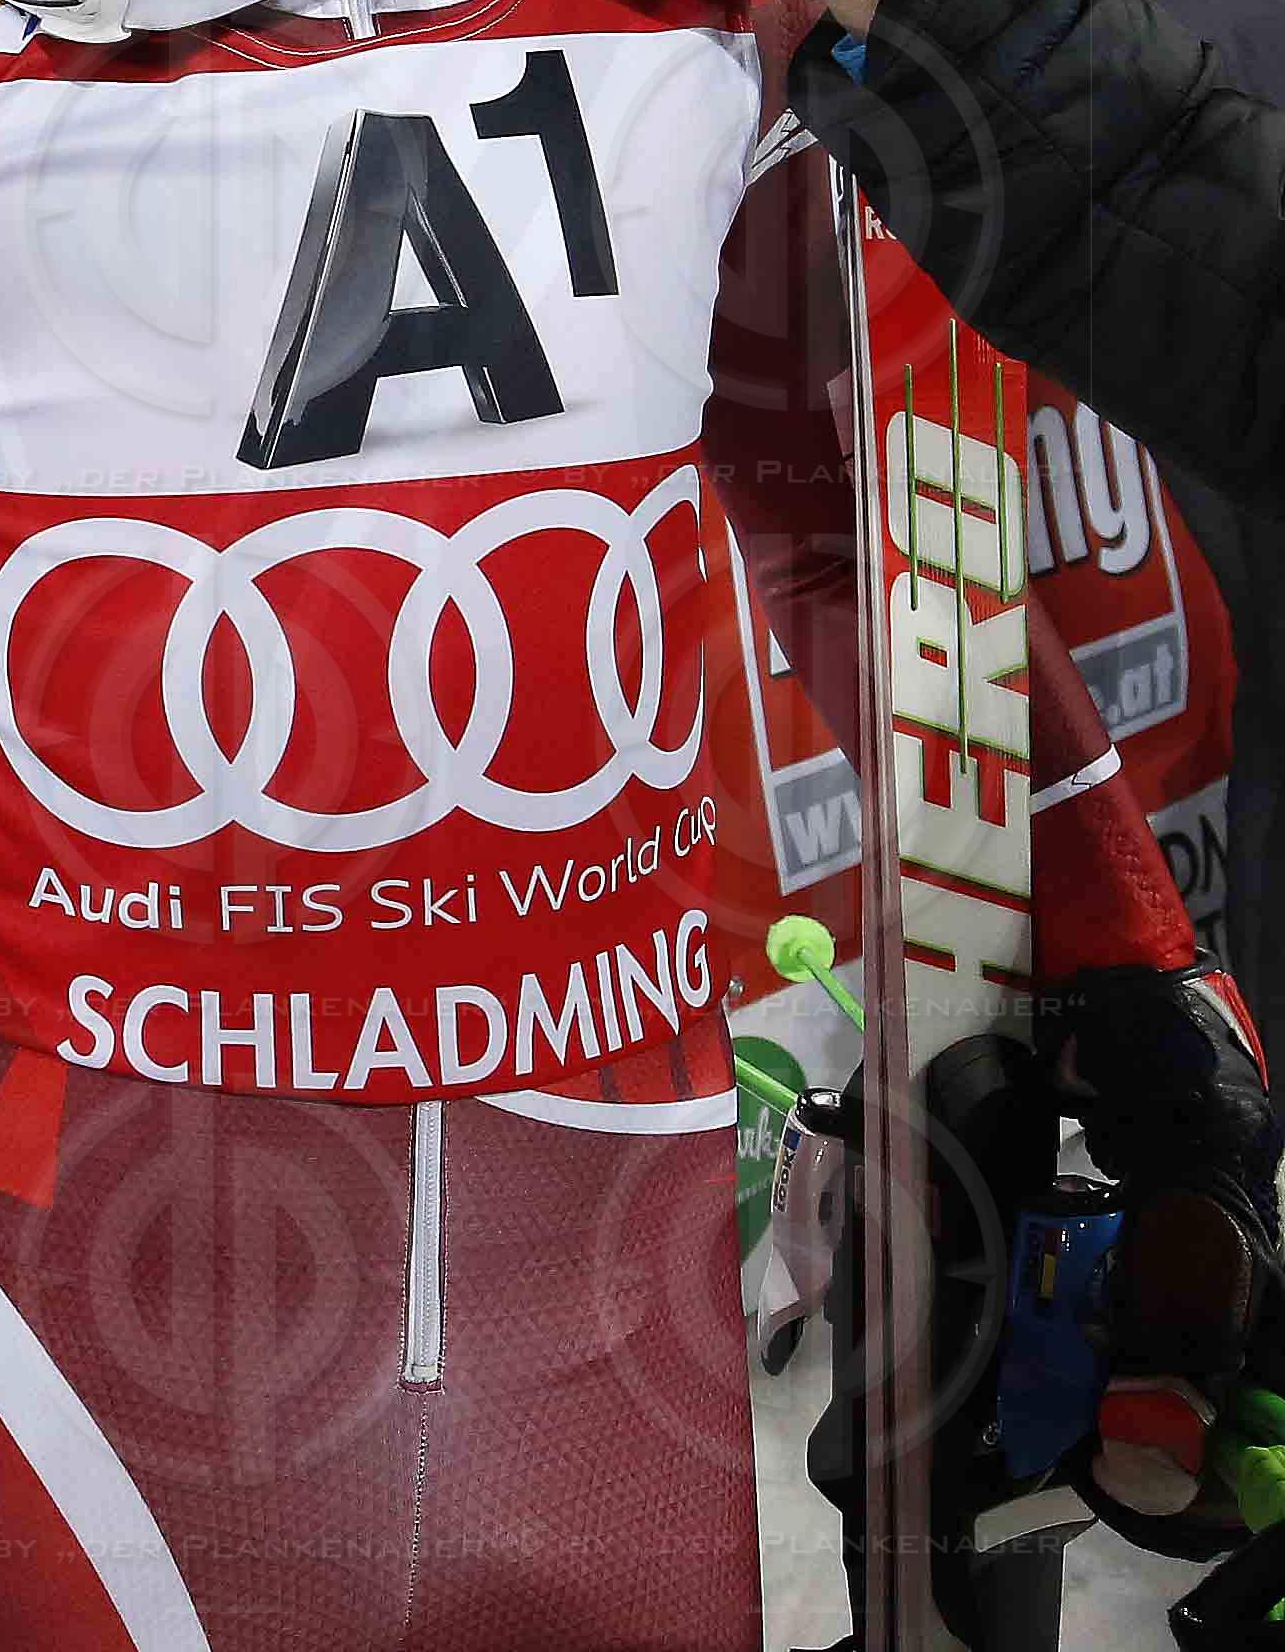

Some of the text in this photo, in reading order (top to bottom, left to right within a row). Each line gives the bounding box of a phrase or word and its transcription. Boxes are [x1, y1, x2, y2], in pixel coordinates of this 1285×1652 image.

[236, 49, 619, 470] A1
[28, 794, 718, 934] Audi FIS Ski World Cup
[56, 907, 714, 1091] SCHLADMING
